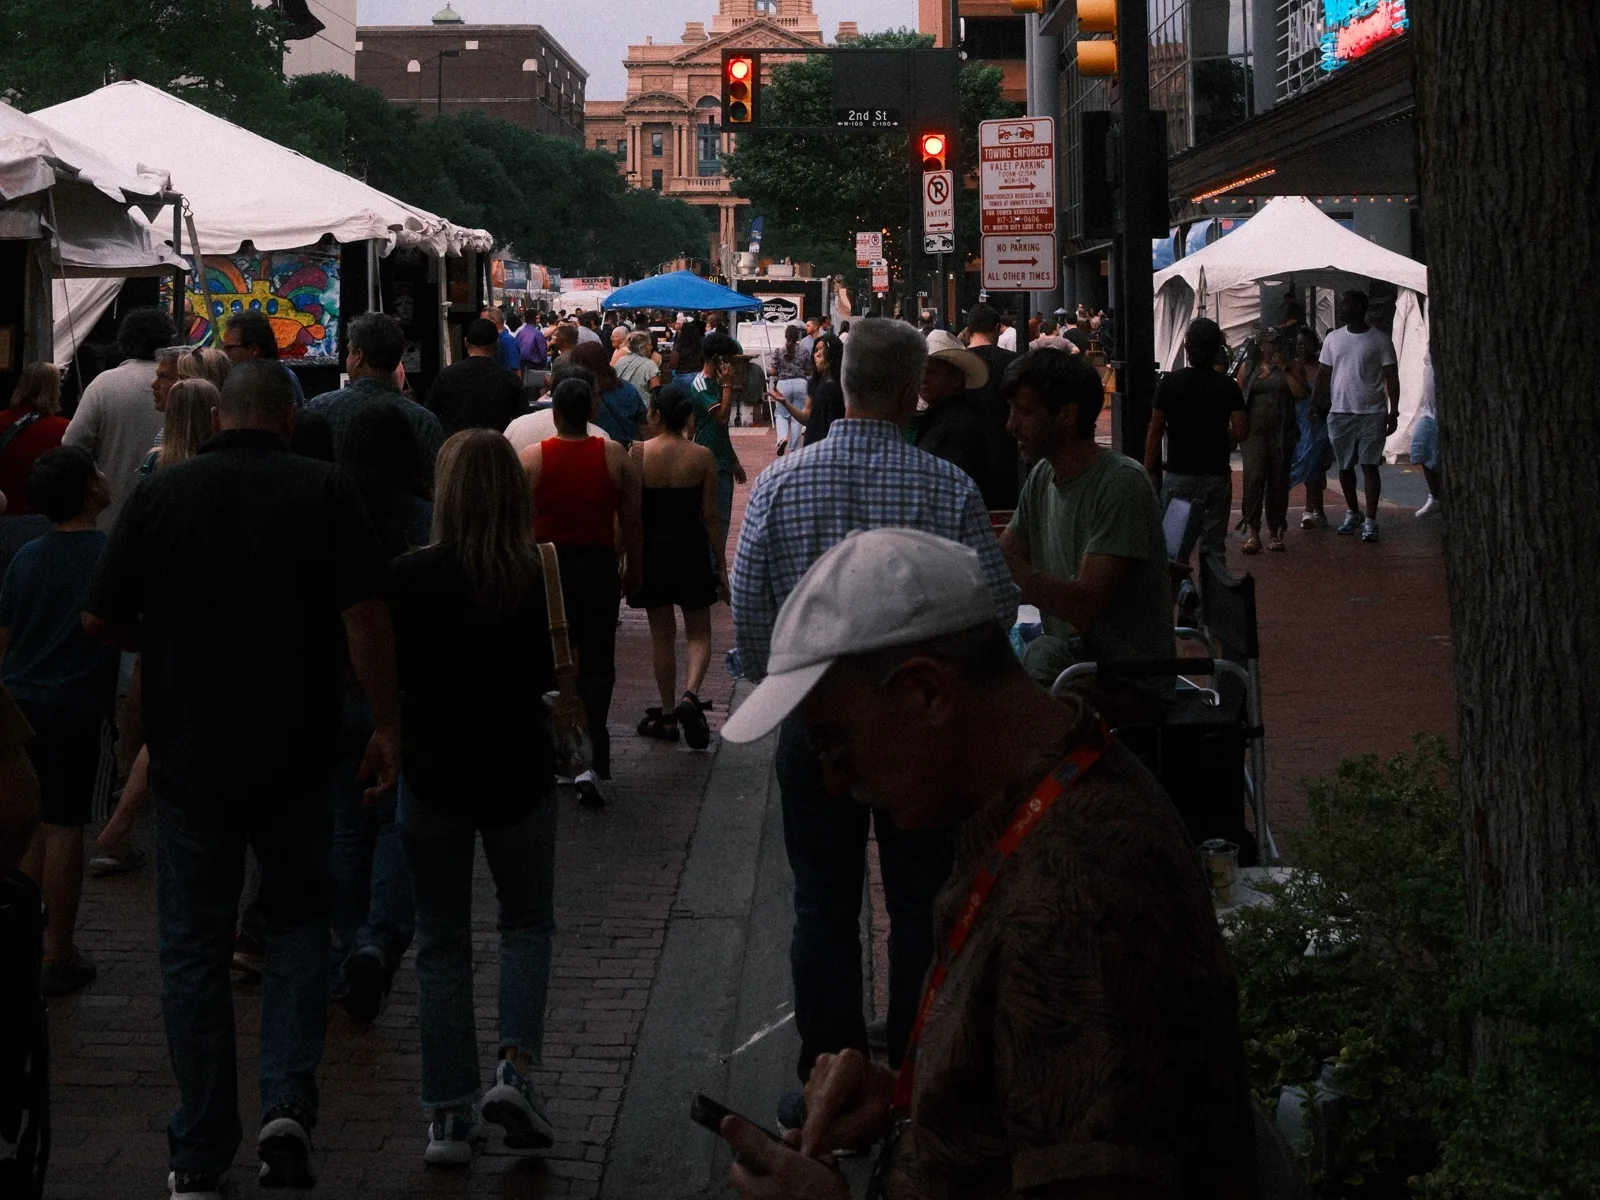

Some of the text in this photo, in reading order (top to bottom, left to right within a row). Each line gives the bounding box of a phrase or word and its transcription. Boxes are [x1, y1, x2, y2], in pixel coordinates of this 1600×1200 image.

[848, 110, 887, 121] 2nd St
[985, 146, 1049, 159] TOWING ENFORCED
[990, 160, 1045, 171] VALET PARKING
[926, 209, 951, 218] ANYTIME
[996, 243, 1040, 252] NO PARKING
[988, 272, 1050, 280] ALL OTHER TIMES
